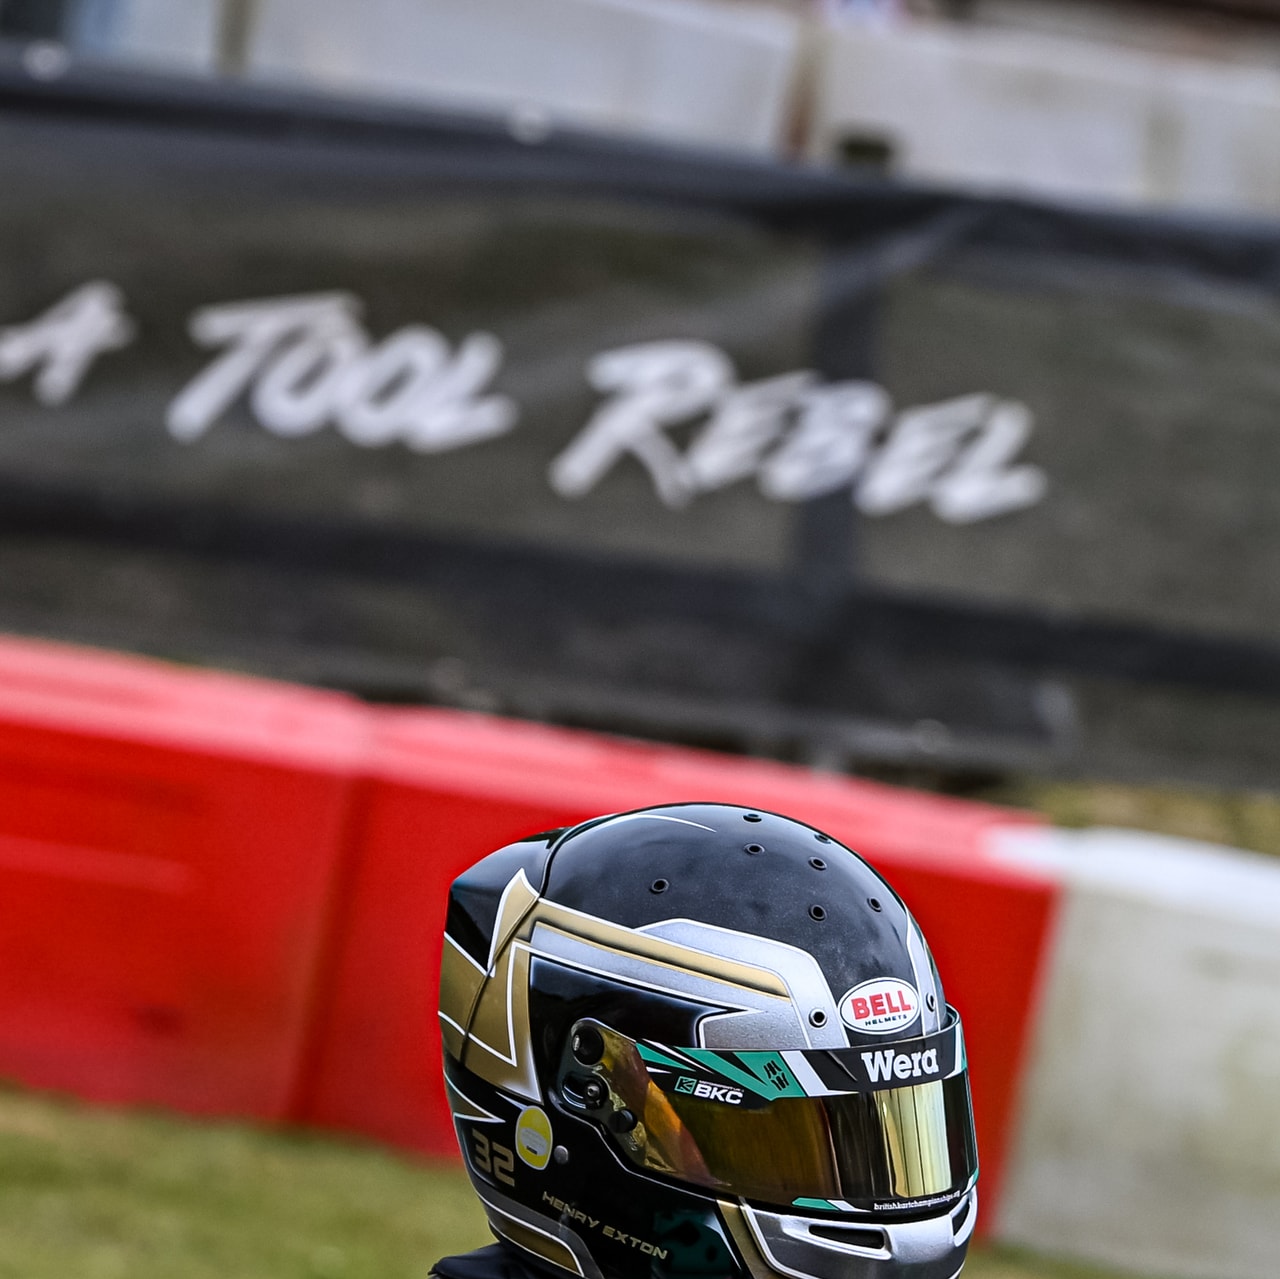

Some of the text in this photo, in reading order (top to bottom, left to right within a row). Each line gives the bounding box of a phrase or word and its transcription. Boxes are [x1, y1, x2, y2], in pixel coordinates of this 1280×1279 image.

[167, 291, 517, 454] TOOL
[548, 338, 1048, 526] REBEL
[851, 990, 912, 1020] BELL
[865, 1014, 907, 1026] HELMETS
[861, 1048, 939, 1083] Wera
[694, 1083, 743, 1105] BKC
[472, 1128, 515, 1187] 32
[542, 1191, 669, 1260] HENRY EXTON
